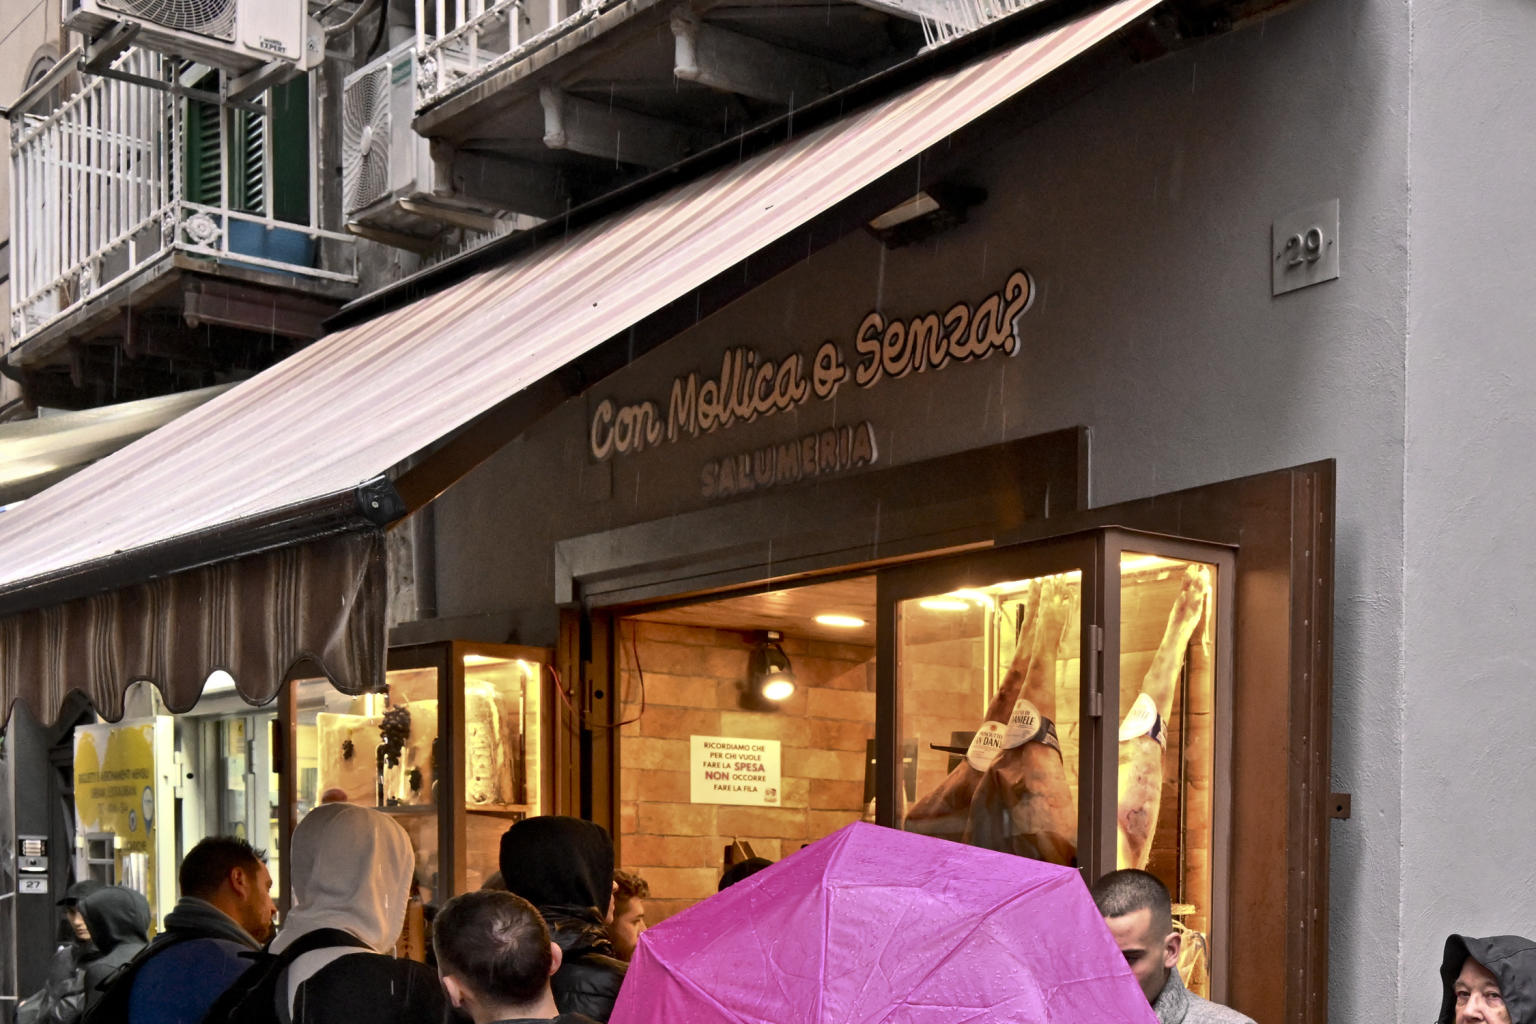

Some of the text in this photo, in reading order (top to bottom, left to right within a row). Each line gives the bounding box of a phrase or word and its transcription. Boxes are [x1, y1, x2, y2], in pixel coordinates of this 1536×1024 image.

[591, 268, 1036, 460] Con Mollica o Senza?
[702, 420, 879, 498] SALUMERIA
[704, 742, 750, 751] RICORDIAMO
[739, 753, 761, 761] VUOLE
[734, 762, 765, 772] SPESA
[705, 771, 766, 782] NON OCCORRE
[25, 881, 41, 889] 27
